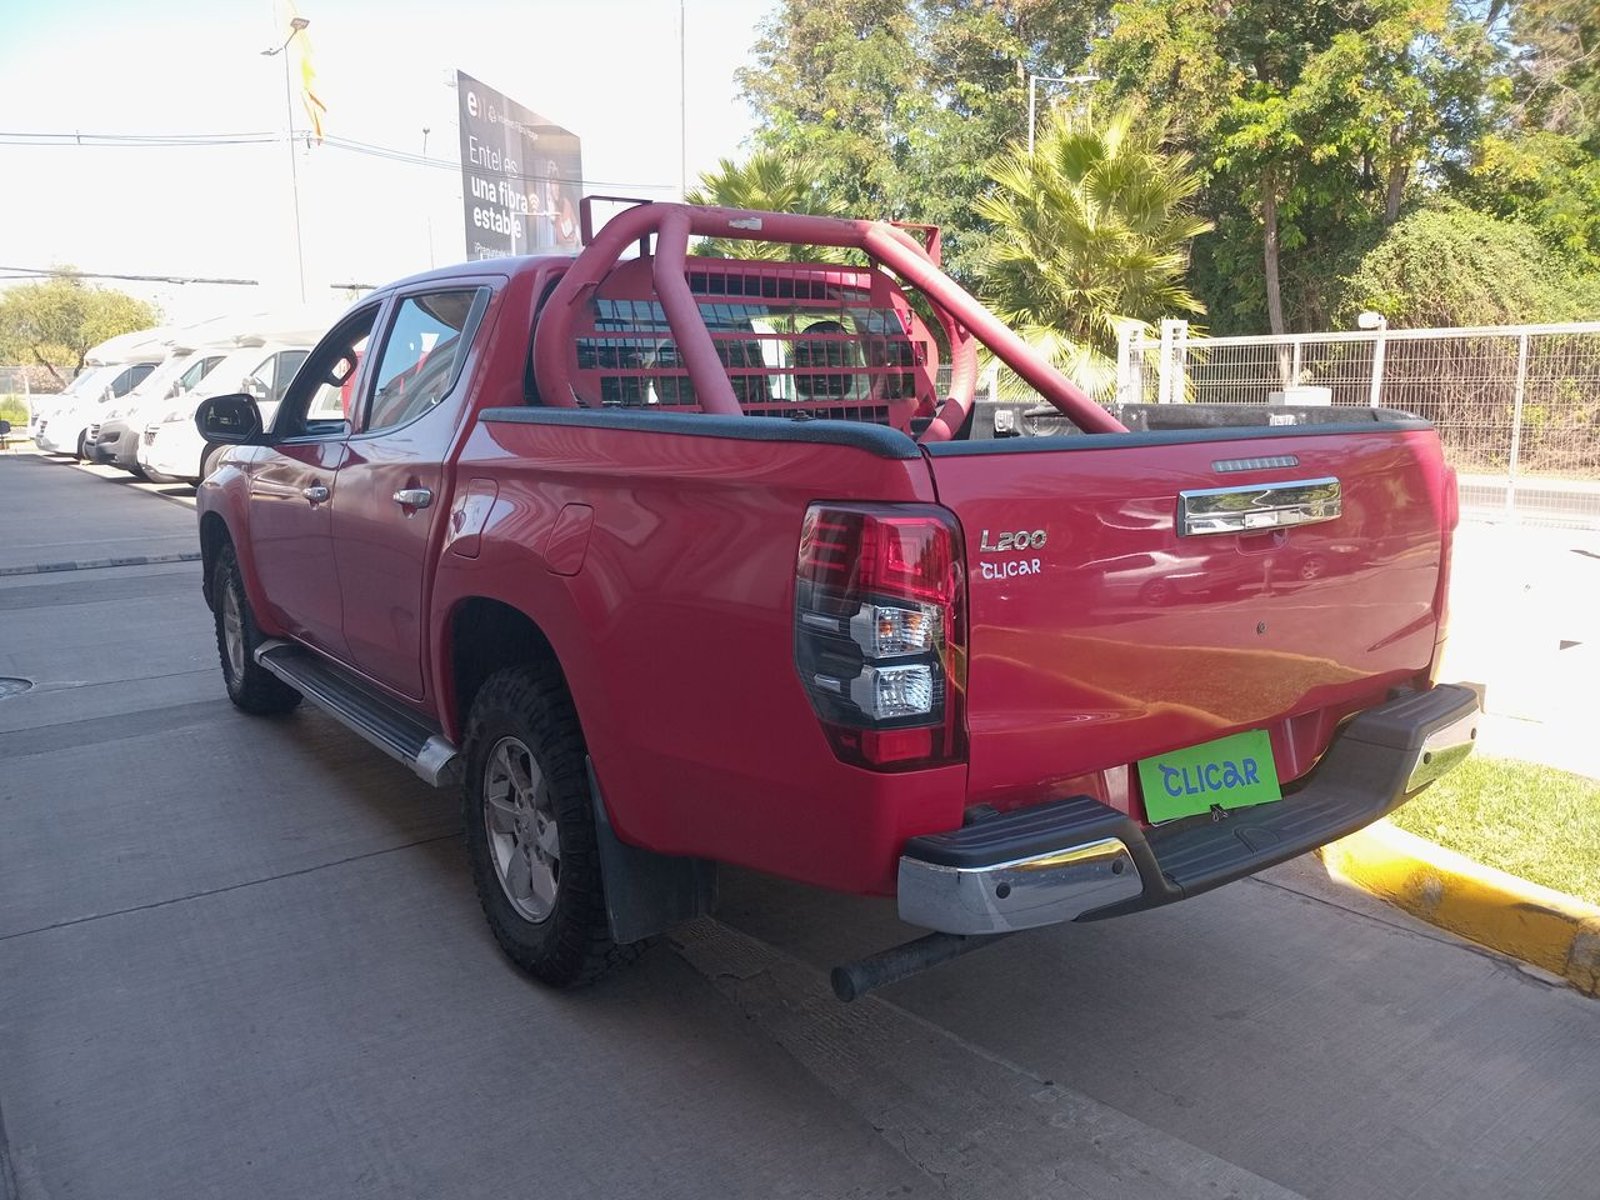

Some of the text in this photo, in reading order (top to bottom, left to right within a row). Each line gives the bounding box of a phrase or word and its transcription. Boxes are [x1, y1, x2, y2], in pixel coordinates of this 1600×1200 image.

[469, 135, 518, 176] Entel es
[471, 176, 529, 213] una fibra
[473, 205, 522, 239] estable
[980, 529, 1047, 552] L200
